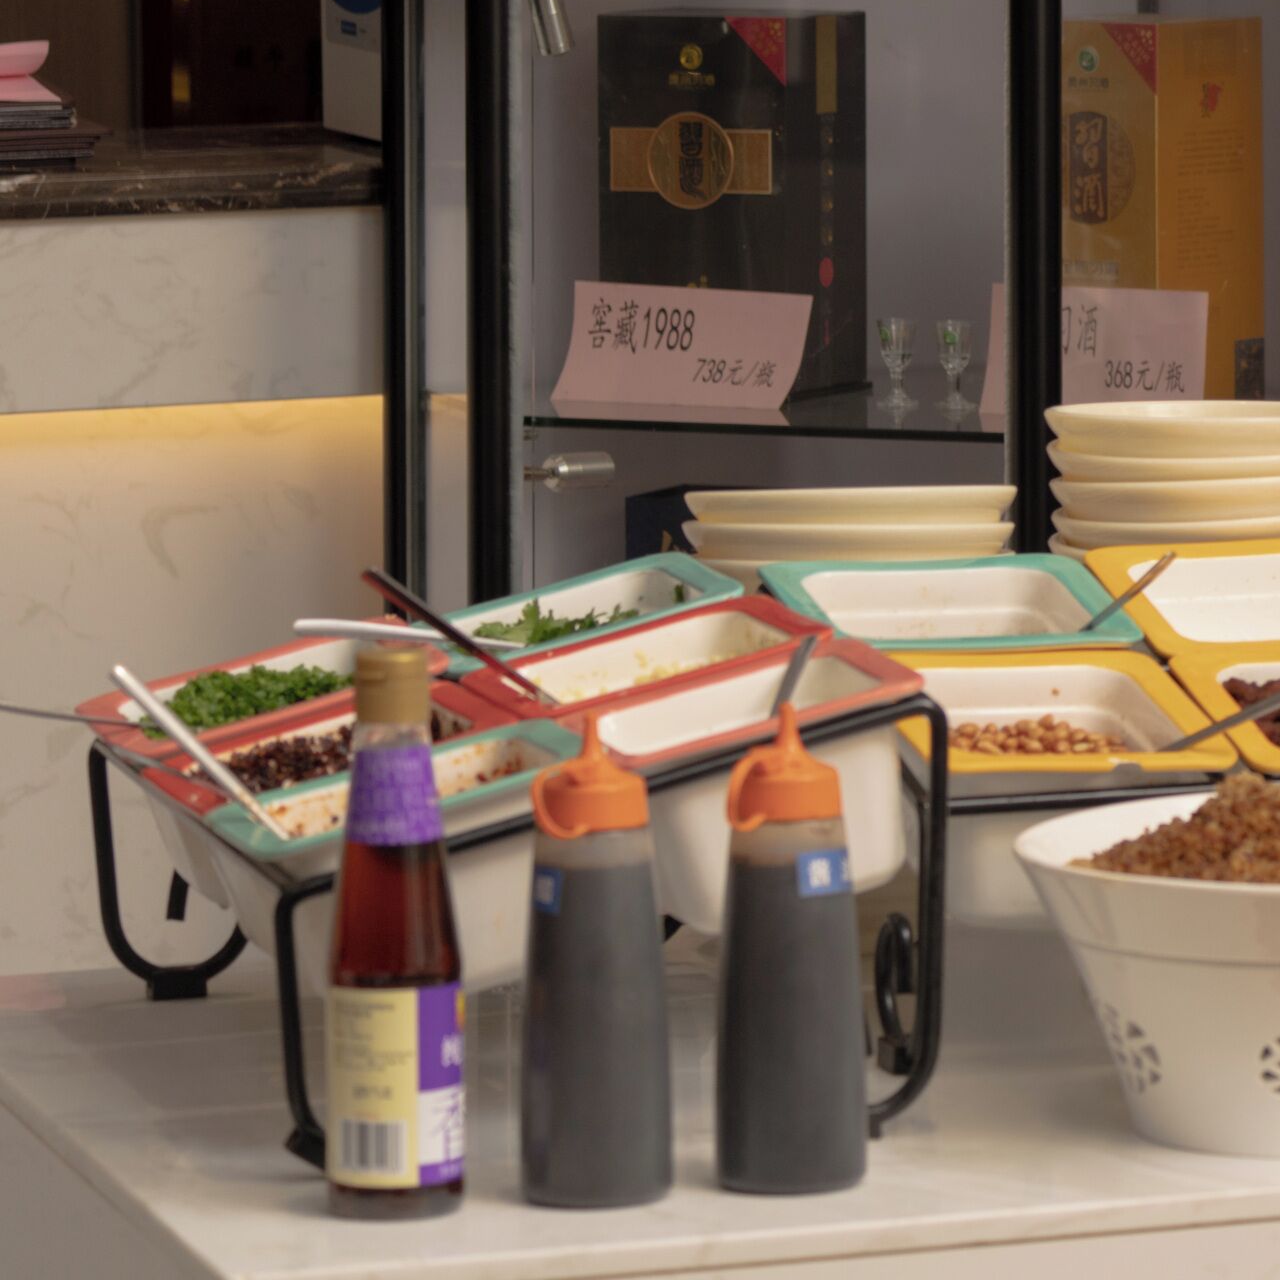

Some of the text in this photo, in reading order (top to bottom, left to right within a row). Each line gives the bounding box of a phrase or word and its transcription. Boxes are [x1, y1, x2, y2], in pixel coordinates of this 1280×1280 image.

[588, 297, 696, 354] 窖藏1988
[692, 357, 777, 388] 738元/瓶
[1104, 360, 1185, 394] 368元/瓶
